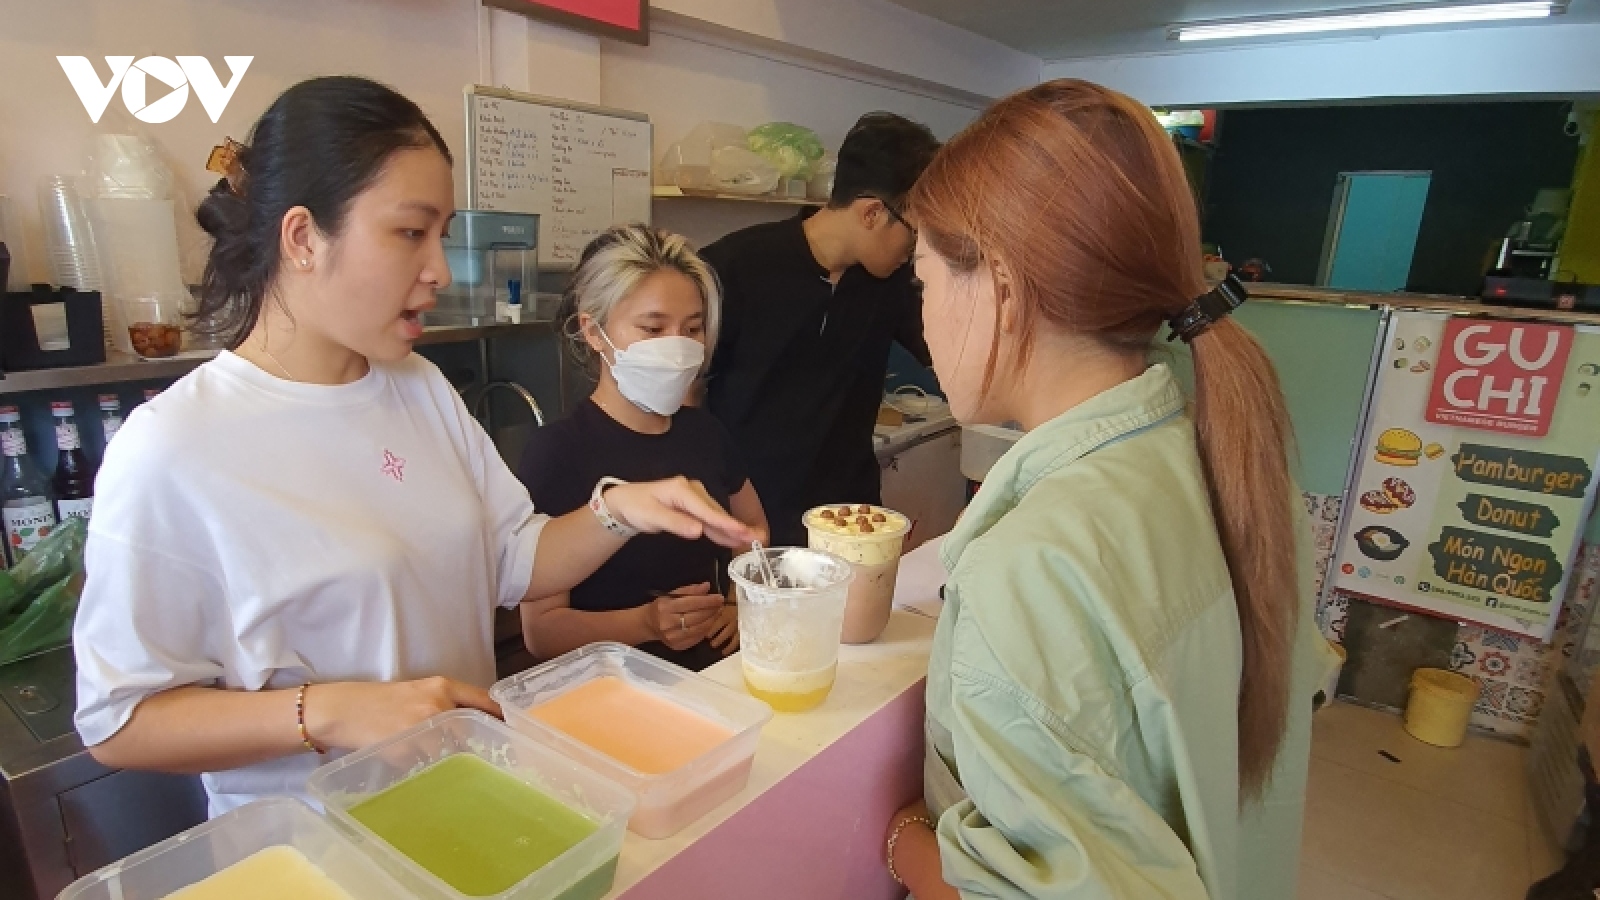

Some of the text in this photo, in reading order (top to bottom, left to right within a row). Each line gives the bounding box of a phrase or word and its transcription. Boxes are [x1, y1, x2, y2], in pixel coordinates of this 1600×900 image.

[1453, 325, 1561, 371] GU
[1443, 368, 1548, 415] CHI
[1457, 452, 1585, 494] Hamburger
[1477, 497, 1542, 528] Donut
[1443, 535, 1547, 575] Món Ngon
[1447, 561, 1489, 588] Hàn
[1491, 573, 1544, 601] Quốc
